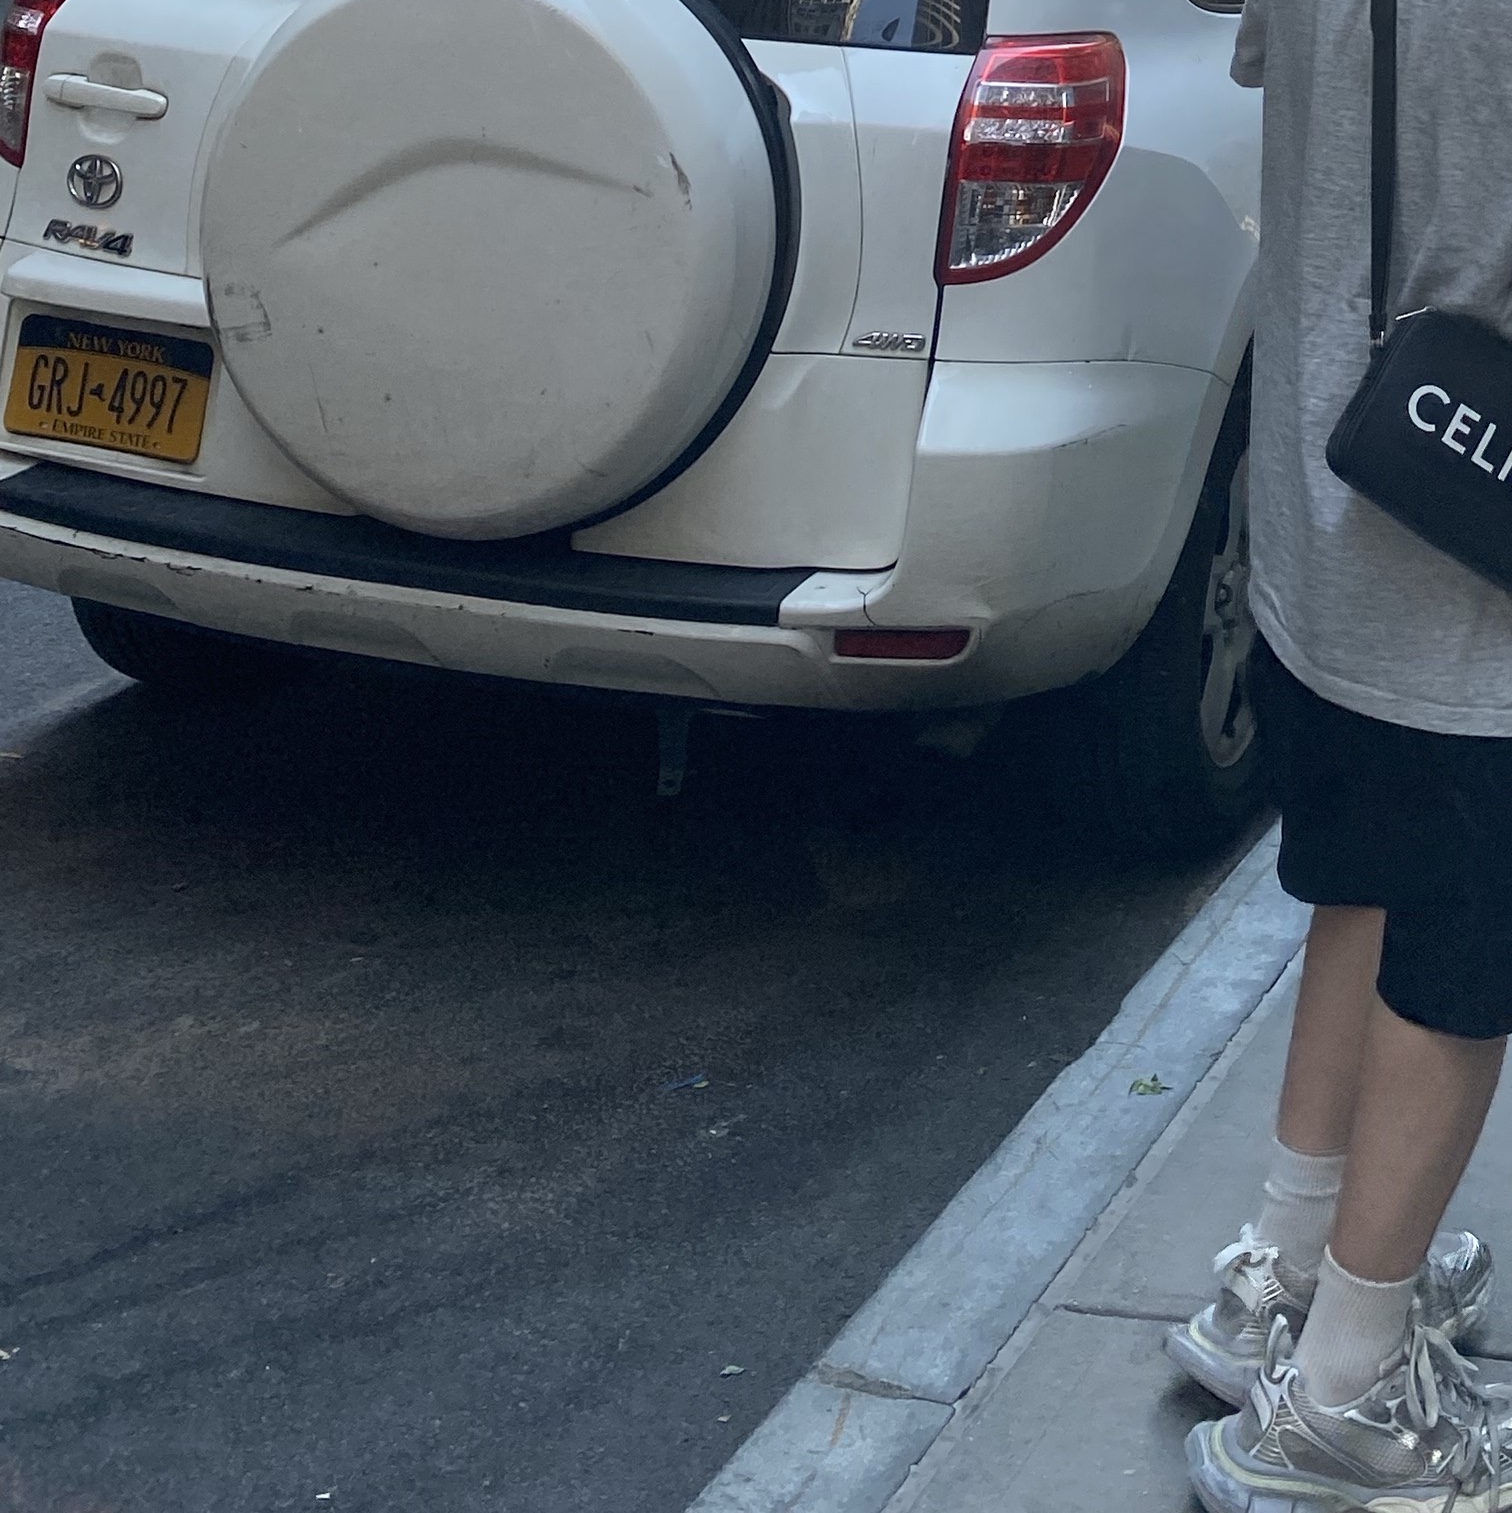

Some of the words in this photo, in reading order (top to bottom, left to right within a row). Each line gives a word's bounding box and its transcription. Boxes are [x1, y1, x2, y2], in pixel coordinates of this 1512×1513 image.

[43, 218, 134, 257] RAV4
[68, 332, 112, 352] NEW
[117, 339, 166, 363] YORK
[107, 368, 188, 434] 4997
[52, 419, 108, 440] EMPIRE
[109, 430, 150, 449] STATE
